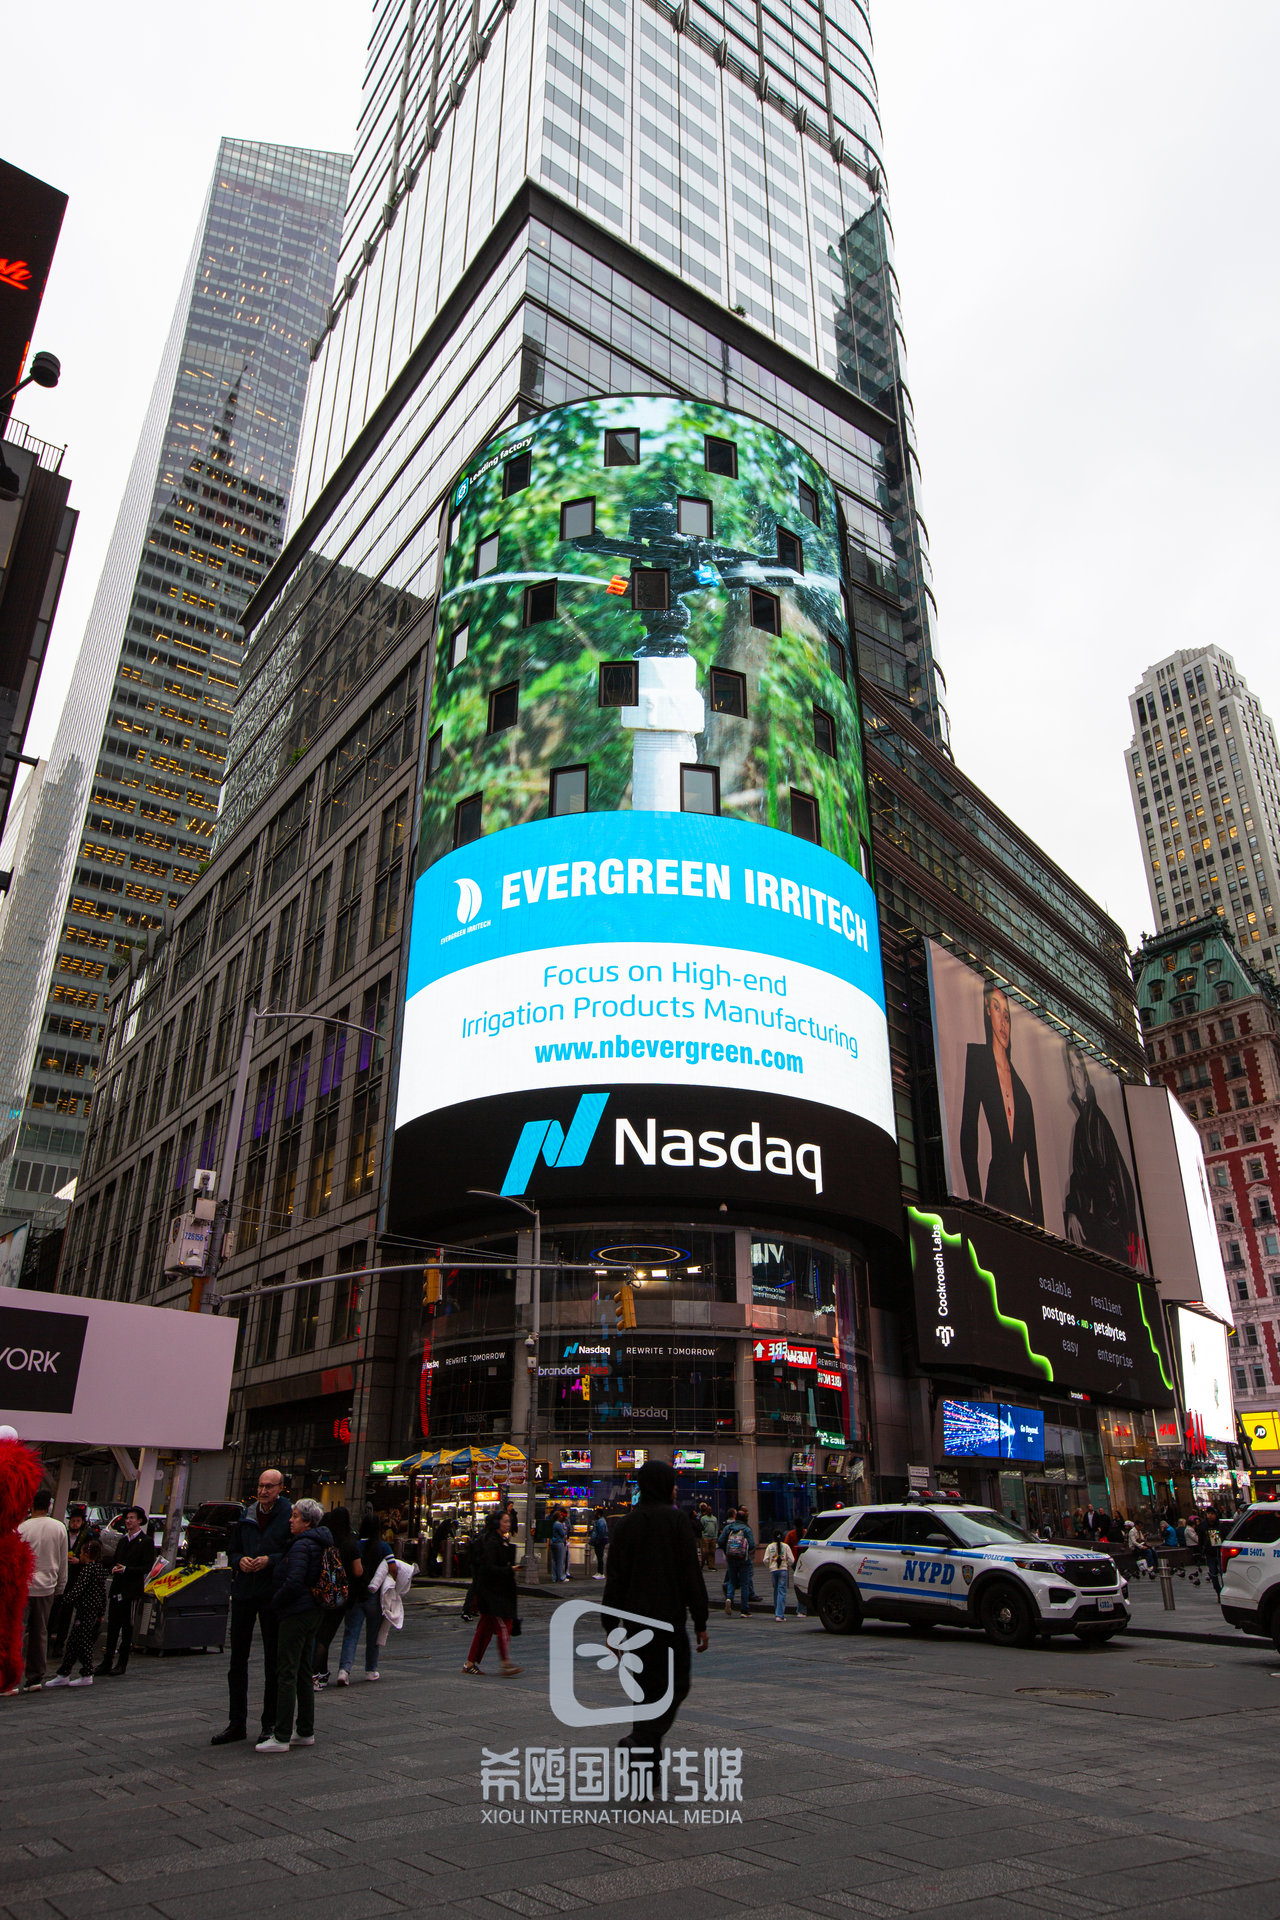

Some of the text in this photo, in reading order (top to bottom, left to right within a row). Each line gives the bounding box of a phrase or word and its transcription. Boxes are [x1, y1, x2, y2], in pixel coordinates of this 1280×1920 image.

[470, 437, 532, 484] Leading factory
[501, 858, 869, 953] EVERGREEN IRRITECH
[544, 961, 787, 996] Focus on High-end
[462, 994, 858, 1059] Irrigation Products Manufacturing
[535, 1033, 803, 1073] www.nbevergreen.com
[615, 1117, 823, 1194] Nasdaq
[931, 1223, 949, 1317] Cockroach Labs
[1038, 1277, 1072, 1298] scalable
[1090, 1295, 1123, 1317] resilient
[1041, 1305, 1076, 1326] postgres
[1093, 1321, 1127, 1341] petabytes
[445, 1356, 467, 1366] REWRITE
[469, 1352, 506, 1362] TOMORROW
[578, 1345, 716, 1356] Nasdaq REWRITE TOMORROW
[1062, 1339, 1079, 1357] easy
[1097, 1348, 1134, 1369] enterprise
[538, 1364, 609, 1376] brandedcities
[623, 1405, 669, 1421] Nasdaq
[983, 1553, 1005, 1561] POLICE
[902, 1559, 956, 1586] NYPD
